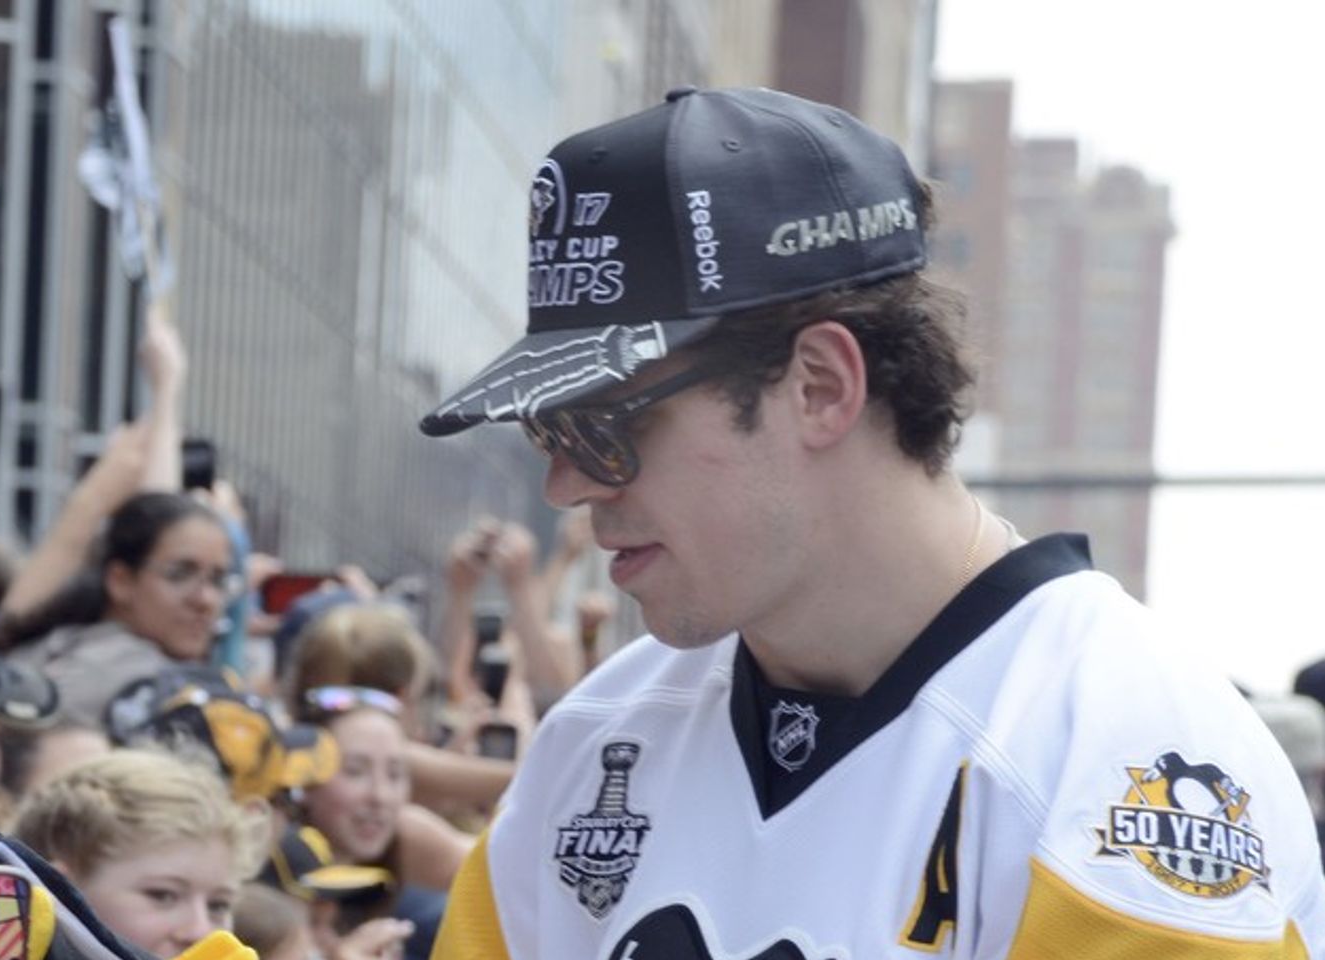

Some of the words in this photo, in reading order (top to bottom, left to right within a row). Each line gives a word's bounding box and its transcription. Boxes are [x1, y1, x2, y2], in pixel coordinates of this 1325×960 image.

[567, 235, 619, 260] CUP
[686, 190, 725, 293] Reebok
[765, 198, 918, 257] CHAMPS
[557, 828, 642, 857] FINA
[1114, 809, 1160, 844] 50
[1170, 813, 1263, 871] YEARS
